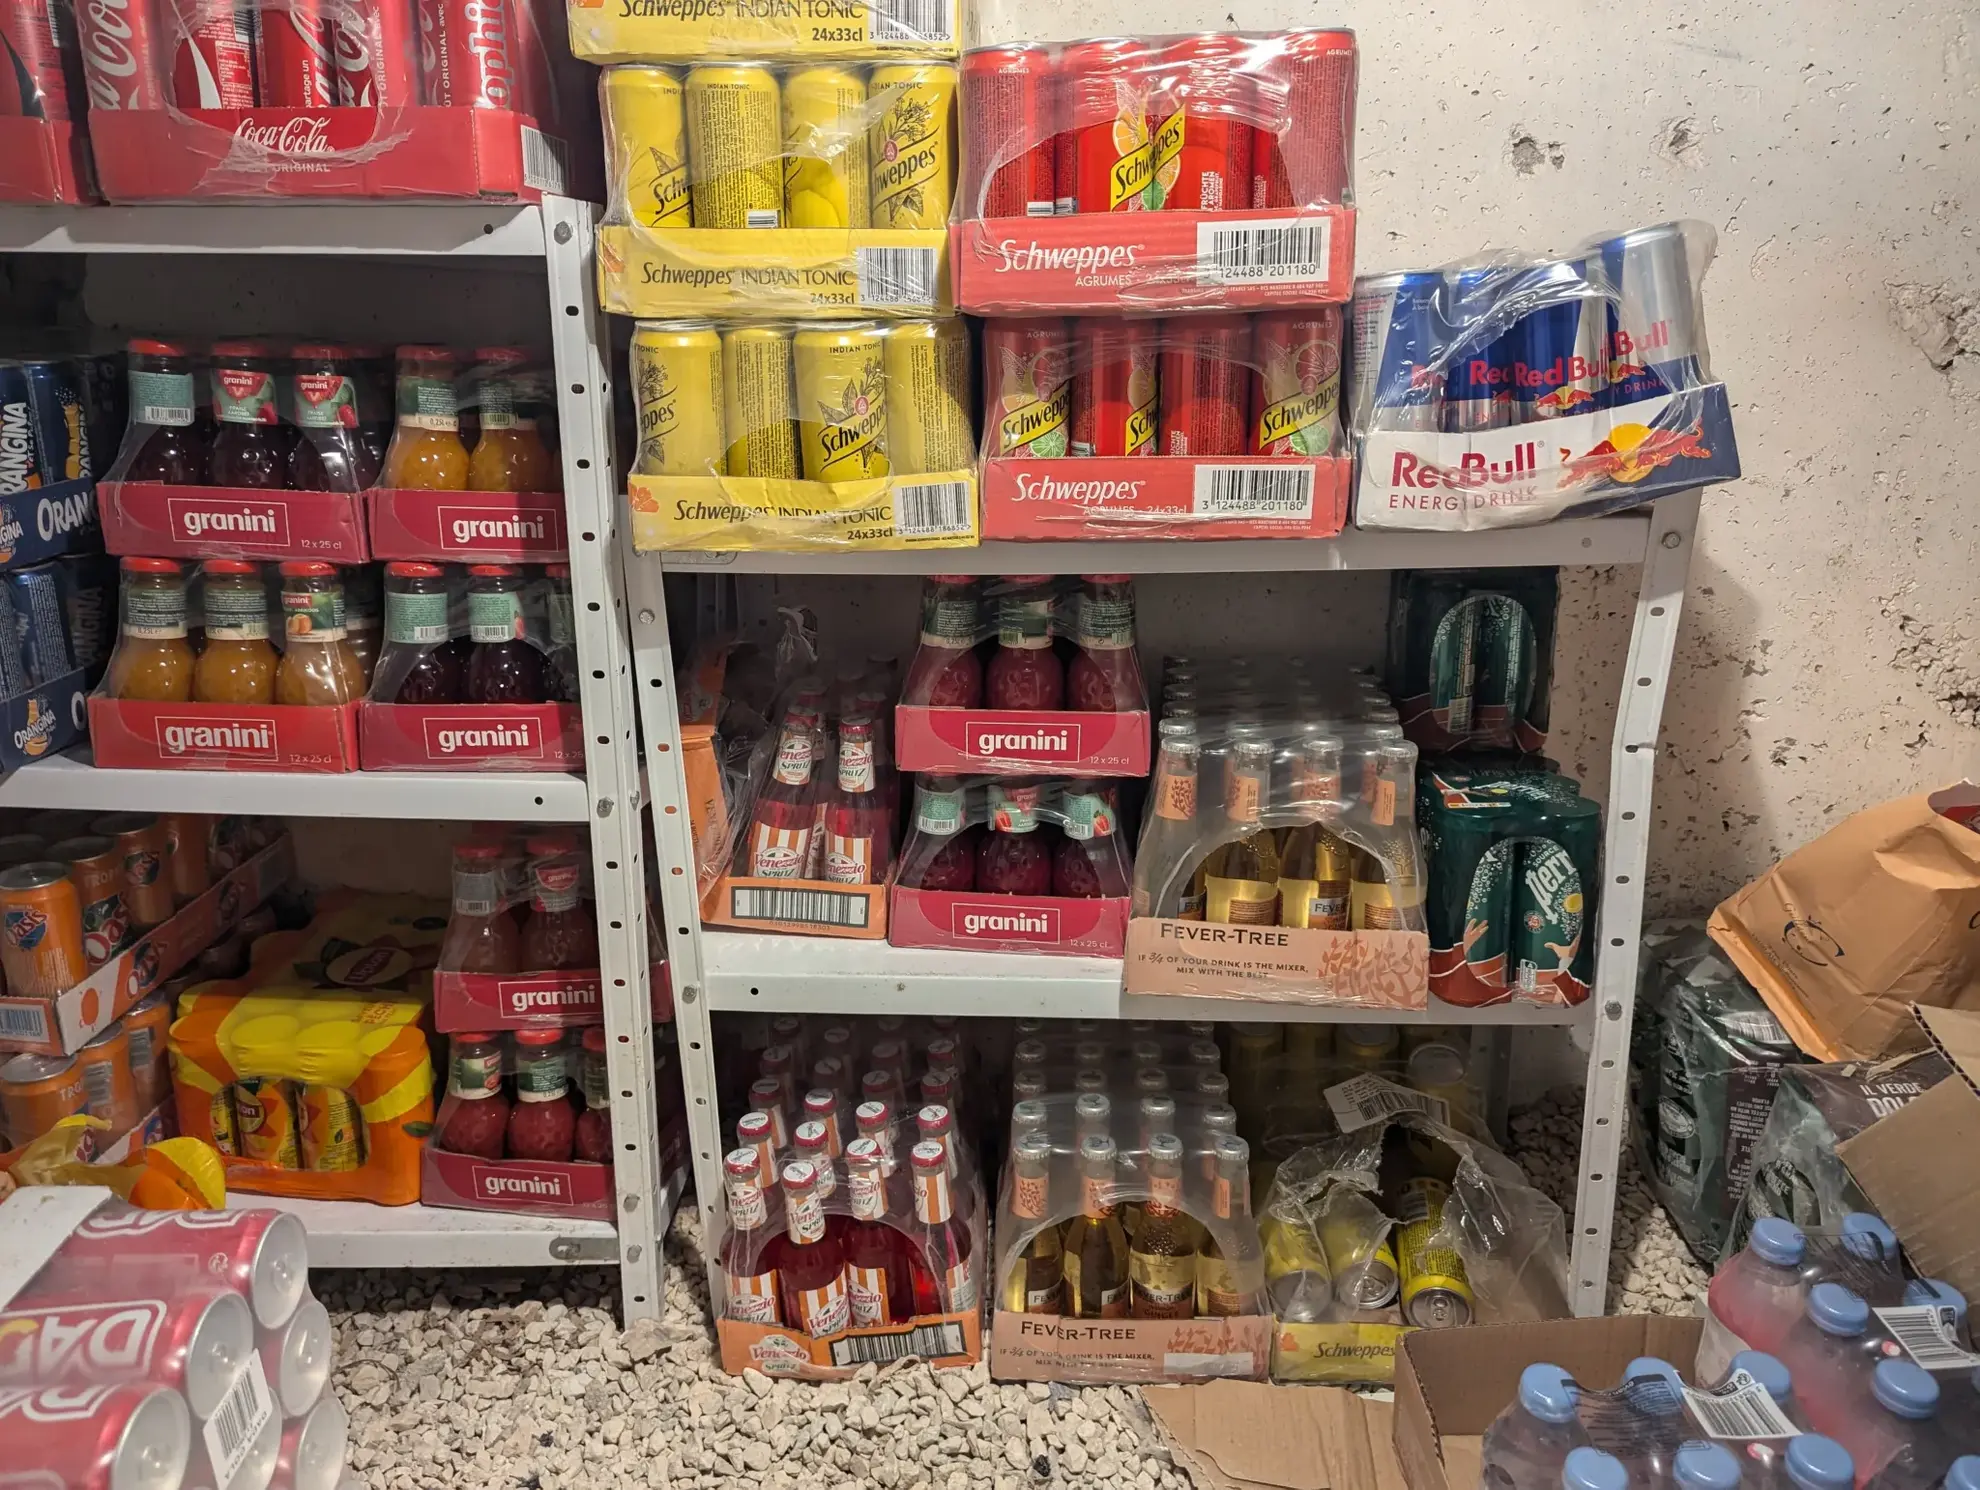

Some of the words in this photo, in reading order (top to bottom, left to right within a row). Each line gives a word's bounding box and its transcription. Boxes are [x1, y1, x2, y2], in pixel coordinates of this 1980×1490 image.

[618, 0, 724, 22] Schweppes
[735, 0, 801, 18] INDIAN
[807, 0, 863, 18] TONIC
[811, 27, 863, 42] 24x33cl
[376, 31, 387, 91] ORIGINAL
[439, 30, 450, 89] ORIGINAL
[235, 116, 331, 154] Coca-Cola
[874, 147, 937, 191] hweppes
[995, 238, 1136, 275] Schweppes
[640, 262, 733, 289] Schweppes
[741, 268, 800, 286] INDIAN
[804, 269, 855, 286] TONIC
[1075, 273, 1132, 288] AGRUMES
[1220, 266, 1264, 279] 124488
[1270, 264, 1316, 277] 201180
[809, 292, 855, 305] 24x33cl
[829, 345, 861, 354] INDIAN
[1615, 321, 1670, 357] Bull
[1515, 357, 1562, 388] Red
[1460, 442, 1536, 488] Bull
[1012, 473, 1141, 505] Schweppes
[1389, 493, 1467, 512] ENERGY
[1473, 485, 1539, 510] DRINK
[37, 491, 94, 542] ORAN
[673, 499, 769, 524] Schweppes
[840, 506, 892, 525] TONIC
[1202, 501, 1209, 510] 3
[1215, 500, 1256, 511] 124488
[1261, 500, 1303, 511] 201180
[183, 508, 277, 536] granini
[453, 515, 545, 544] granini
[301, 539, 311, 549] 12
[319, 540, 332, 550] 25
[333, 540, 342, 550] cl
[846, 529, 894, 541] 24x33cl
[14, 708, 57, 750] ORANGINA
[165, 723, 270, 754] granini
[438, 724, 530, 753] granini
[978, 729, 1068, 755] granini
[289, 754, 301, 764] 12
[310, 755, 323, 764] 25
[324, 754, 332, 764] cl
[554, 750, 563, 759] 12
[1089, 755, 1100, 764] 12
[1107, 756, 1120, 765] 25
[1120, 756, 1130, 765] cl
[754, 852, 806, 870] Venezzio
[761, 868, 796, 878] SPRITZ
[4, 907, 49, 949] Oasis
[964, 912, 1049, 934] granini
[1069, 938, 1079, 947] 12
[1086, 939, 1098, 948] 25
[1099, 939, 1108, 948] cl
[1160, 922, 1289, 947] FEVER-TREE
[1138, 954, 1146, 962] IF
[1167, 955, 1179, 963] OF
[1181, 956, 1208, 966] YOUR
[1211, 958, 1240, 968] DRINK
[1243, 960, 1253, 968] IS
[1255, 961, 1274, 970] THE
[1276, 963, 1309, 973] MIXER,
[1176, 965, 1195, 975] MIX
[1198, 967, 1224, 977] WITH
[1226, 969, 1244, 978] THE
[511, 984, 596, 1012] granini
[1859, 1084, 1876, 1097] IL
[1876, 1082, 1926, 1095] VERDE
[485, 1176, 561, 1197] granini
[730, 1296, 776, 1315] enezzio
[1021, 1320, 1136, 1341] FEVER-TREE
[1026, 1350, 1039, 1358] OF
[1094, 1353, 1104, 1361] IS
[1106, 1353, 1123, 1361] THE
